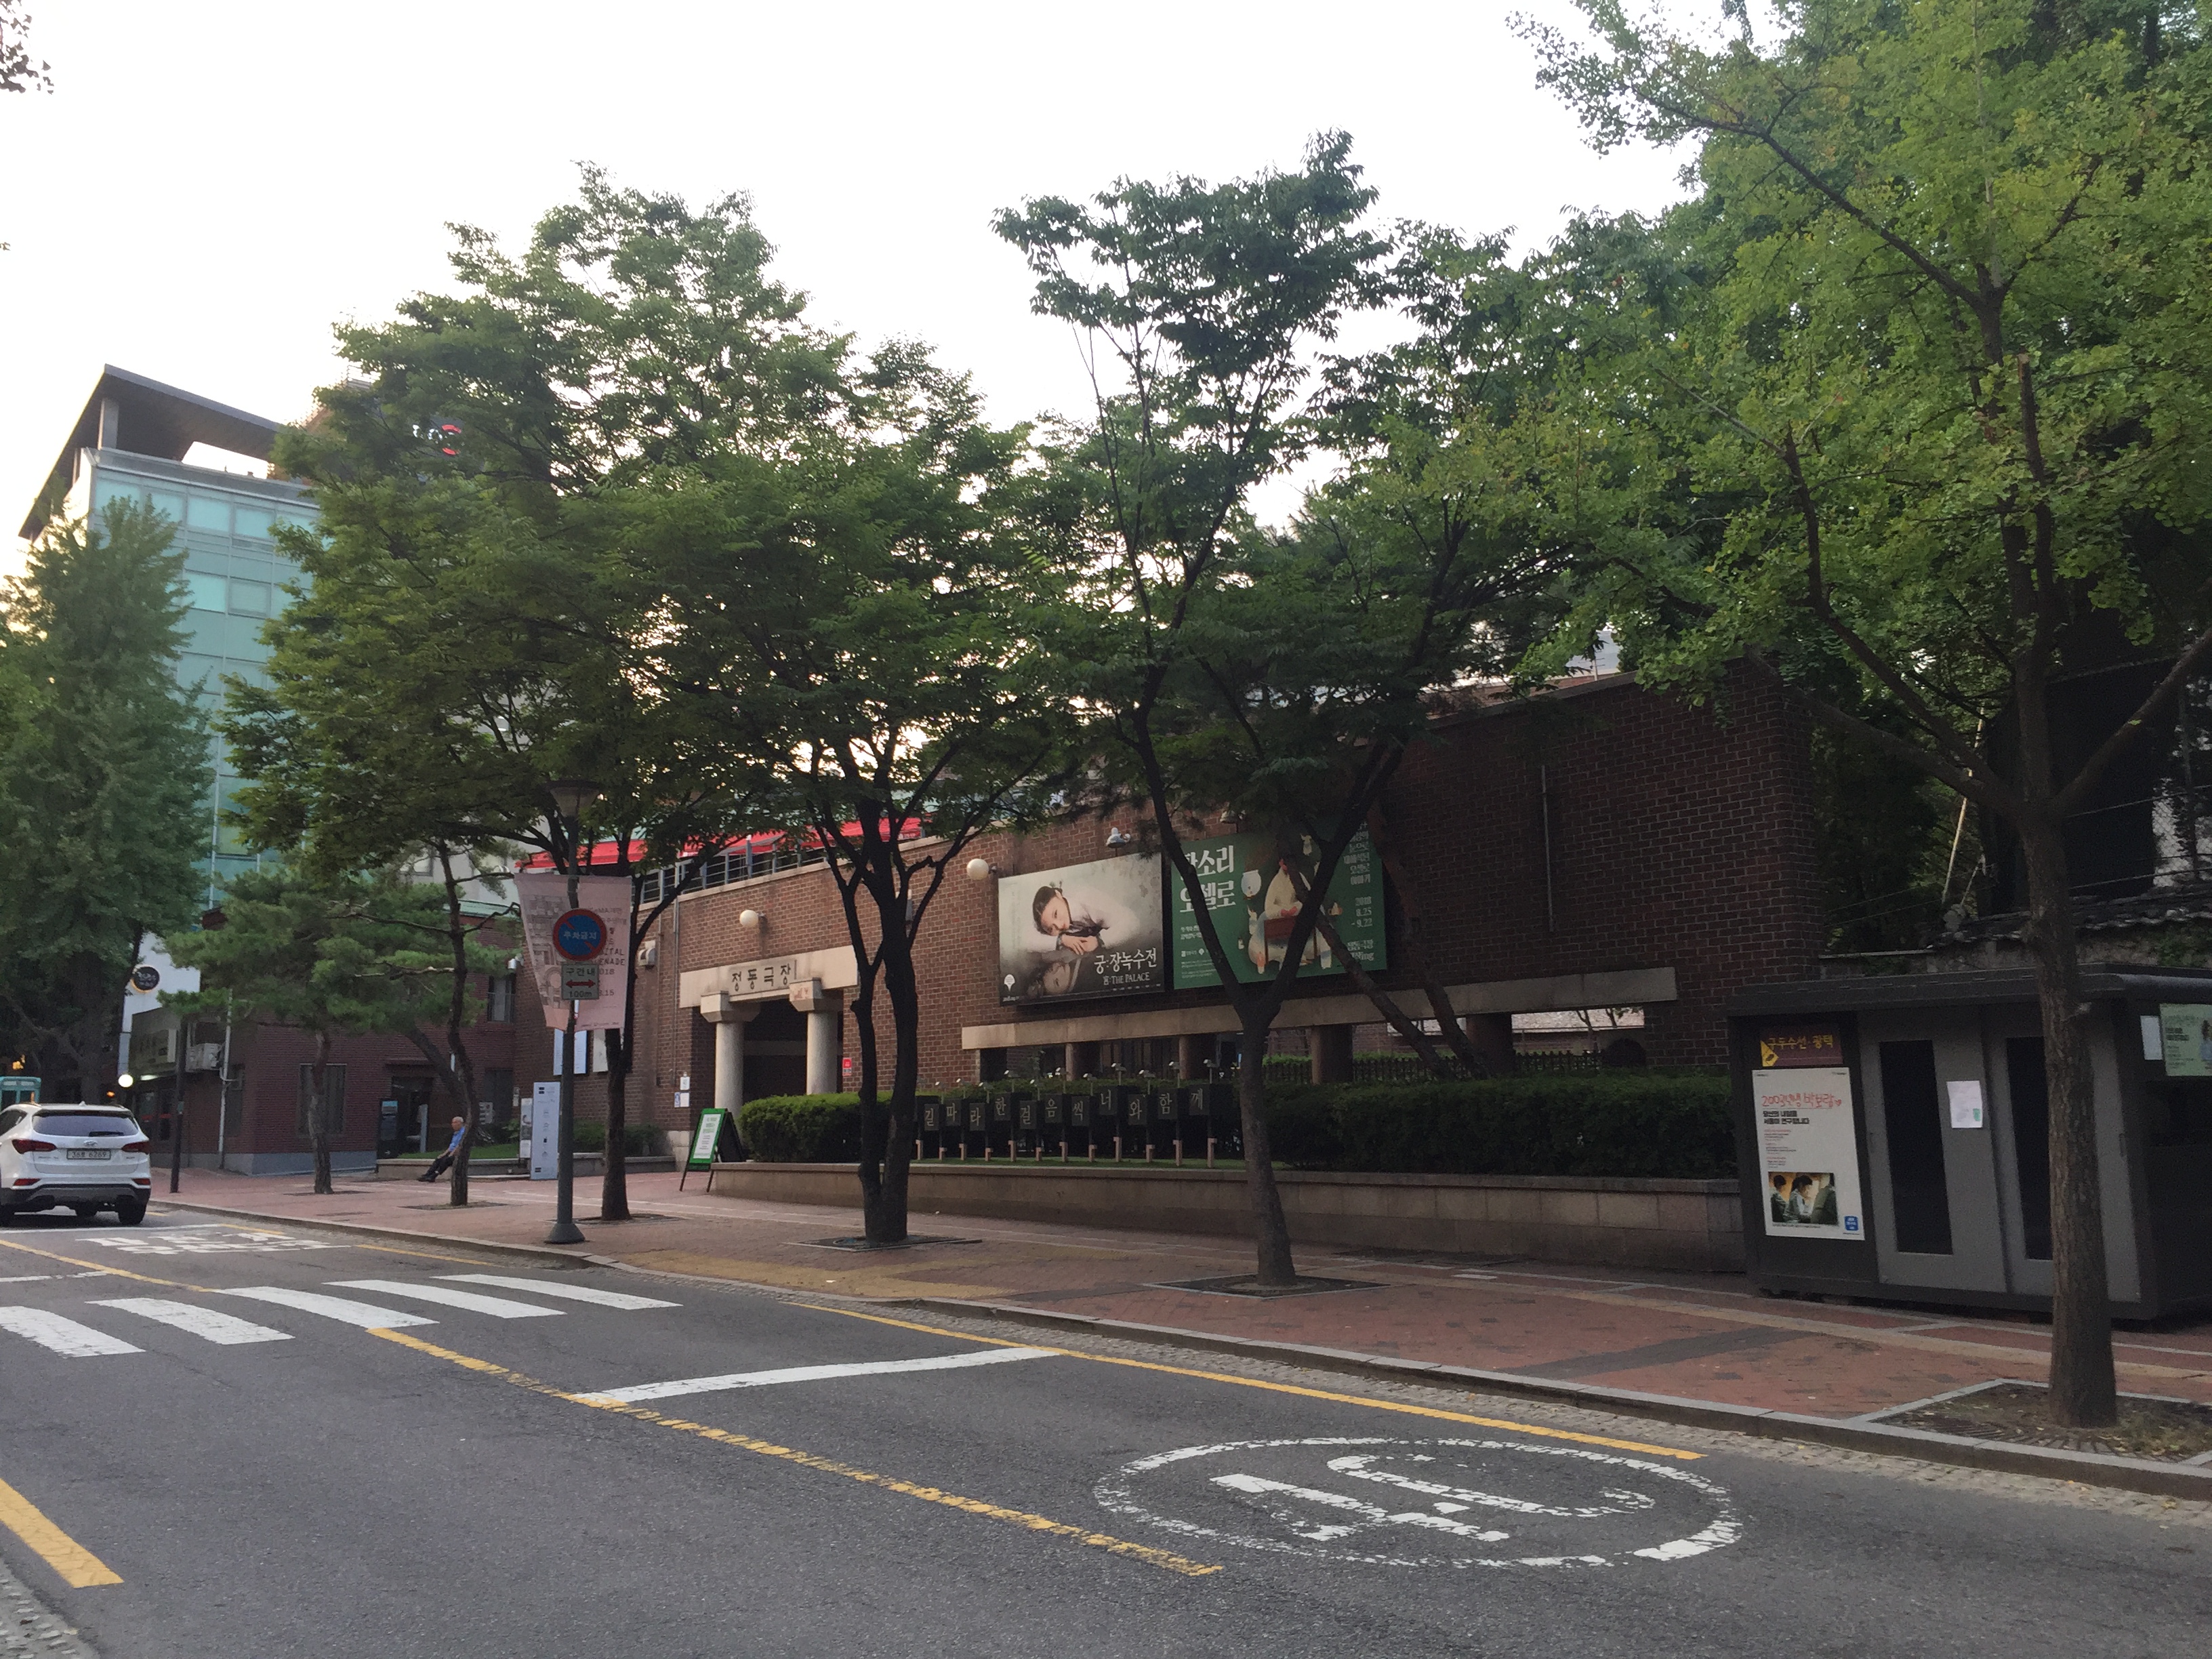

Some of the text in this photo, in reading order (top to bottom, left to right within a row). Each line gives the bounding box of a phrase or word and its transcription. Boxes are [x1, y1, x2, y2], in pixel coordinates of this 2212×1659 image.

[563, 930, 597, 941] 주차금지
[1094, 947, 1157, 975] 궁:장녹수전
[732, 963, 791, 991] 정동극장
[1125, 972, 1150, 983] PALACE
